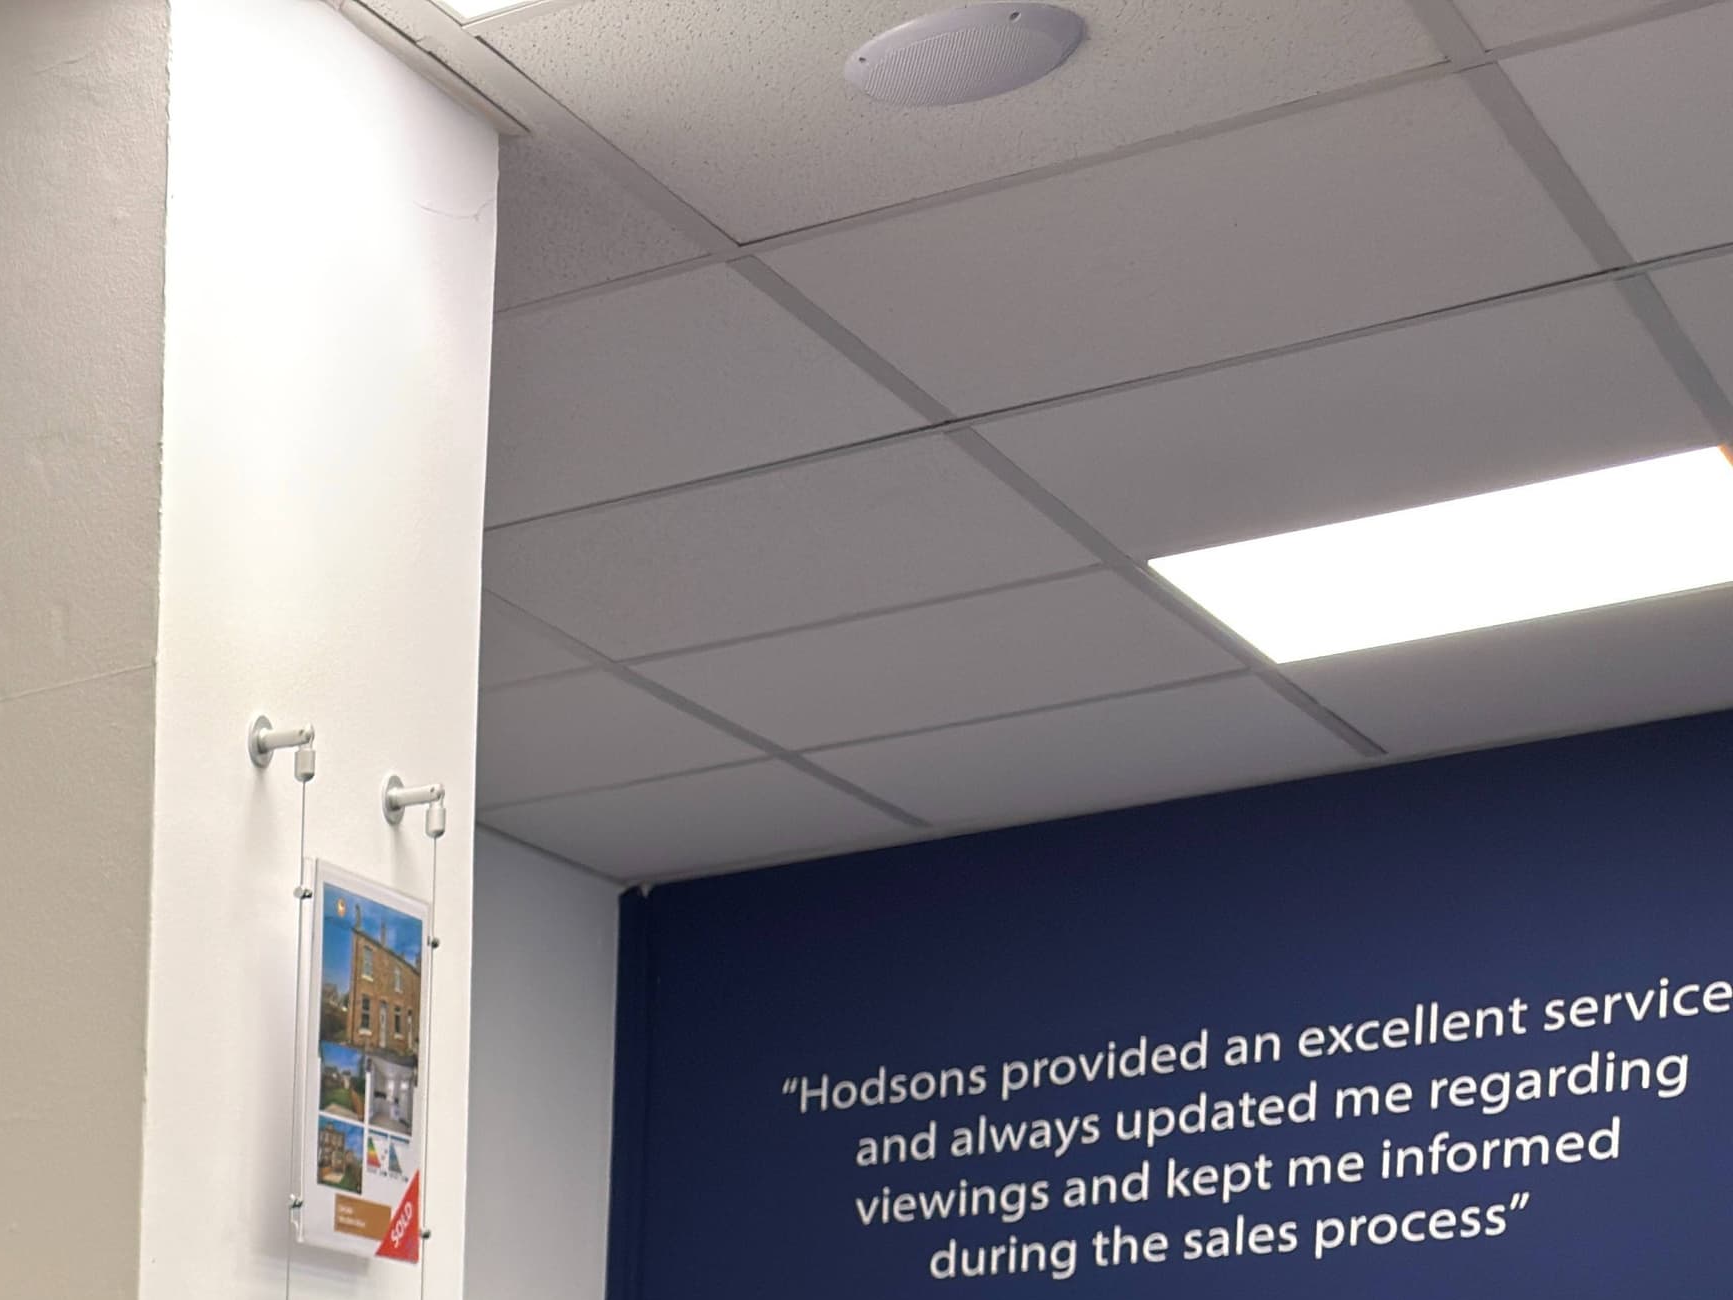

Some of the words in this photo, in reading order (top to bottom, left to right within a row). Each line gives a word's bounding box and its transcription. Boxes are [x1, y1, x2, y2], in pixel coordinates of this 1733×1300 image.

[782, 1066, 986, 1113] “Hodsons
[1001, 1029, 1208, 1100] provided
[1224, 1031, 1281, 1067] an
[1298, 998, 1528, 1058] excellent
[1543, 977, 1733, 1032] service
[856, 1120, 936, 1166] and
[950, 1114, 1100, 1157] always
[1116, 1080, 1317, 1147] updated
[1335, 1081, 1413, 1119] me
[1431, 1051, 1689, 1114] regarding
[391, 1202, 412, 1248] SOLD
[855, 1178, 1049, 1226] viewings
[1063, 1159, 1150, 1208] and
[1167, 1153, 1272, 1203] kept
[1288, 1151, 1364, 1187] me
[1381, 1116, 1621, 1179] informed
[930, 1239, 1077, 1280] during
[1092, 1225, 1169, 1267] the
[1183, 1214, 1298, 1259] sales
[1314, 1192, 1530, 1260] process”
